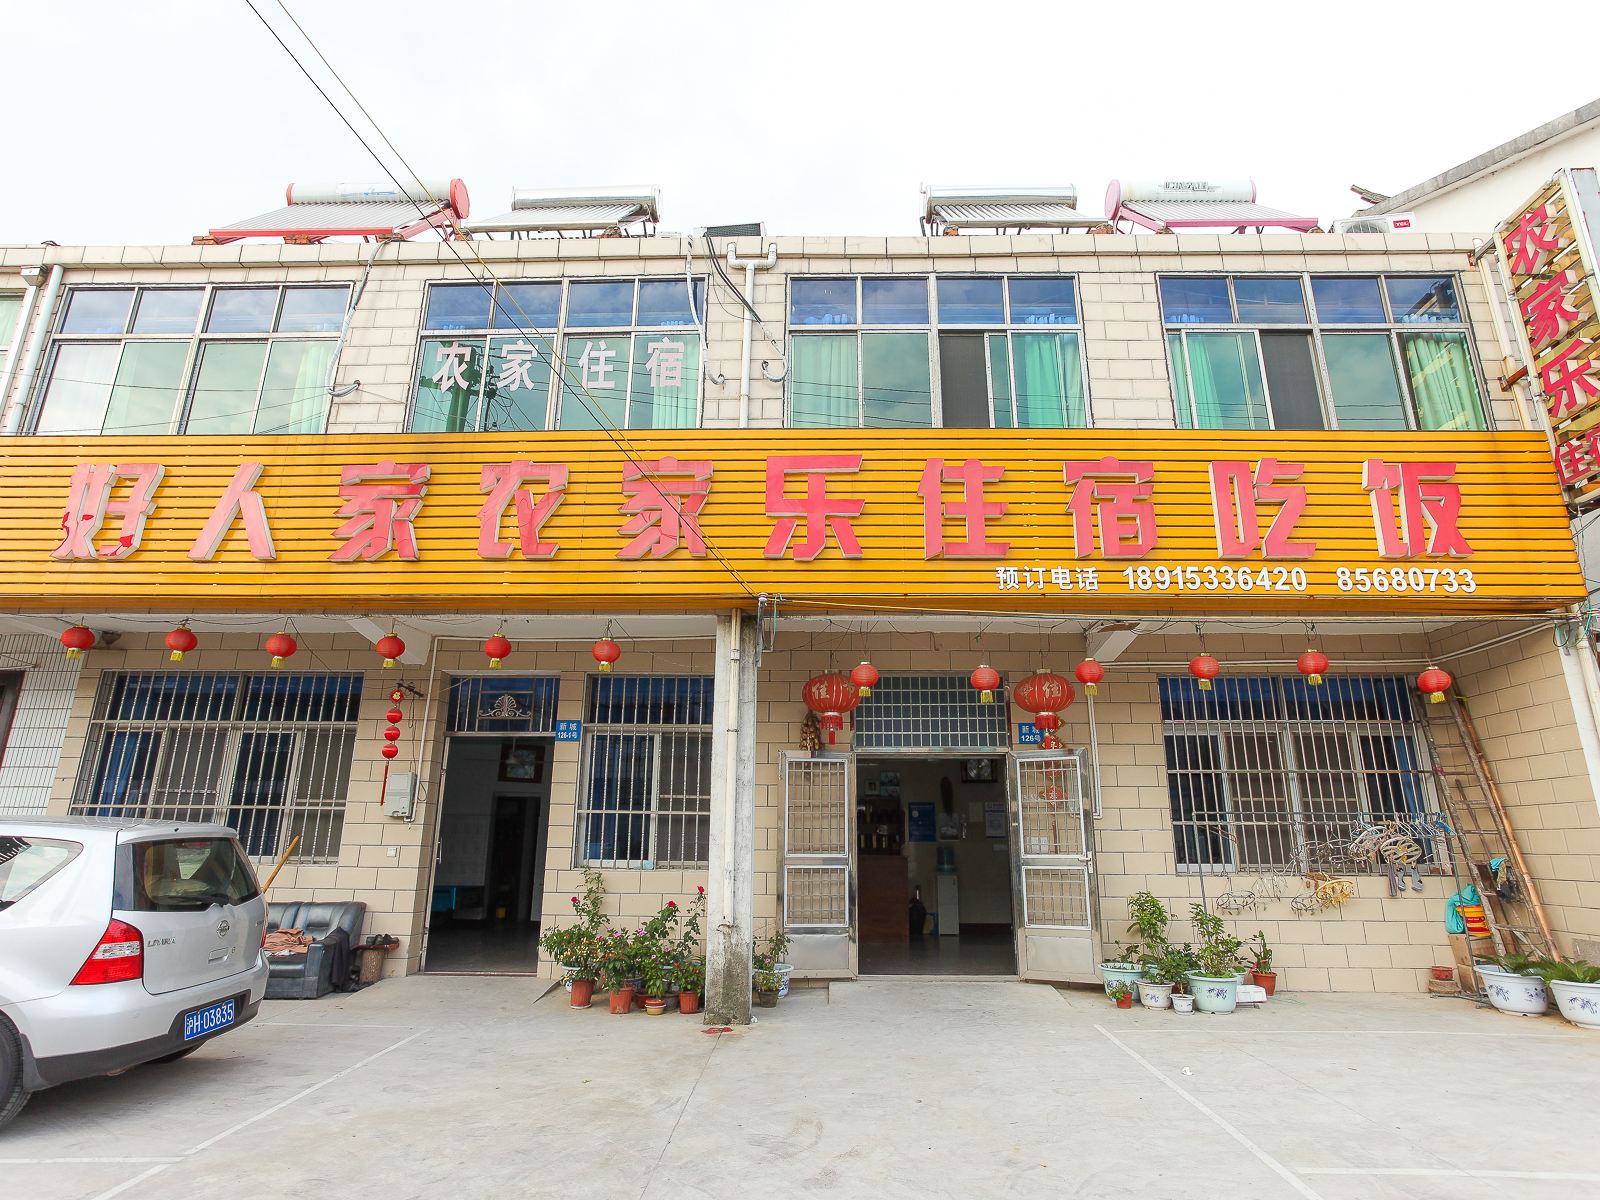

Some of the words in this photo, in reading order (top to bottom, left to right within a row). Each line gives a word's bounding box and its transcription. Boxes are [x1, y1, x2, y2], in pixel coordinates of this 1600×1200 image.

[434, 338, 686, 393] 农家住宿
[50, 456, 1473, 562] 好人家农家乐住宿吃饭
[995, 567, 1099, 591] 预订电话
[1123, 566, 1308, 592] 18915336420
[1336, 566, 1477, 593] 85680733
